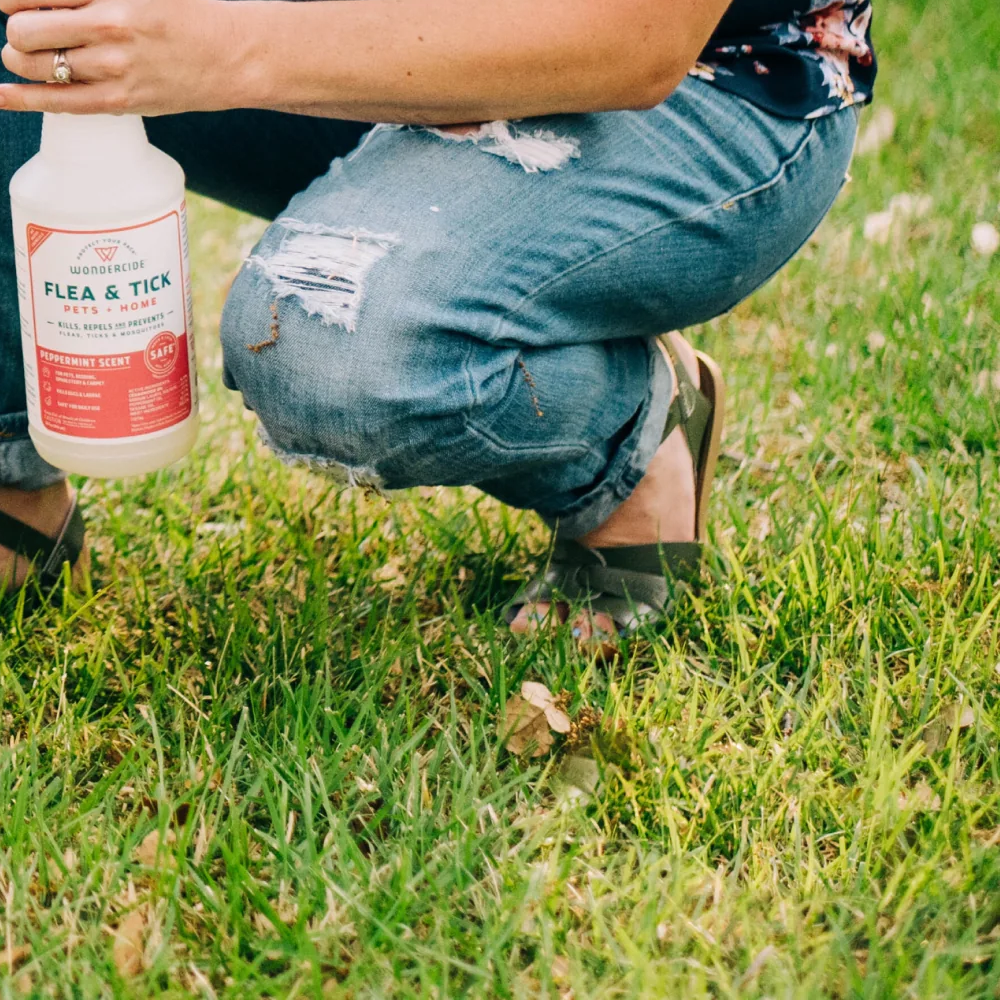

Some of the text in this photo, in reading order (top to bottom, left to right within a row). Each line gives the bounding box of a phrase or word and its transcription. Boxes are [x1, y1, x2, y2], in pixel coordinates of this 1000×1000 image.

[76, 239, 99, 260] PROTECT
[69, 260, 145, 275] WONDERCIDE
[44, 270, 172, 301] FLEA & TICK
[63, 304, 99, 315] PETS
[120, 297, 157, 313] HOME
[83, 323, 113, 331] REPELS
[128, 312, 165, 328] PREVENTS
[40, 350, 131, 368] PEPPERMINT SCENT
[150, 343, 174, 361] SAFE
